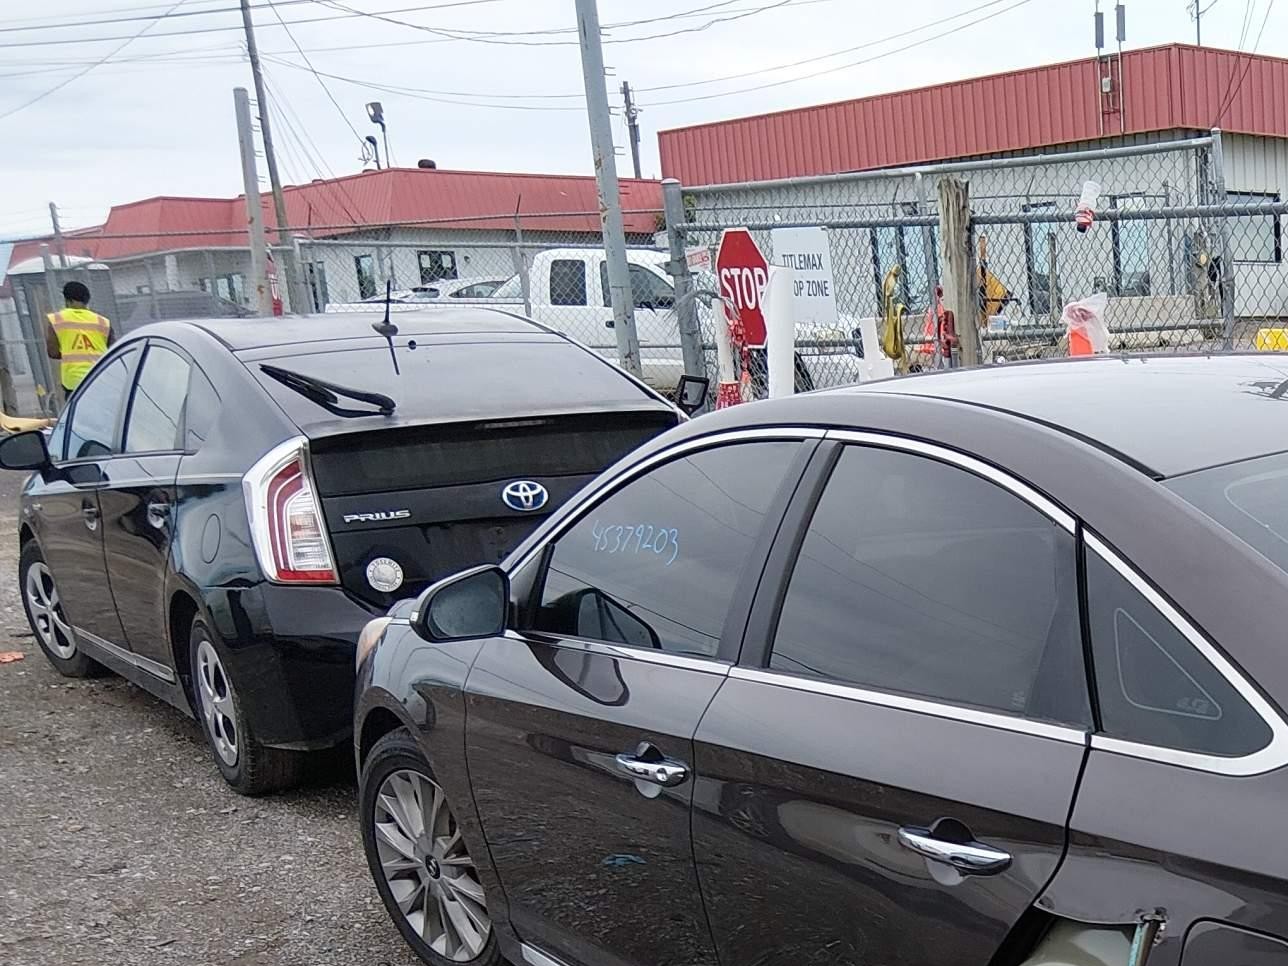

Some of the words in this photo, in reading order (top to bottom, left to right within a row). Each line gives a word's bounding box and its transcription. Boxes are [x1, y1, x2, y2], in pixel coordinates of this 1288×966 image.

[781, 252, 824, 270] TITLEMAX
[721, 267, 767, 310] STOP
[806, 280, 830, 297] ZONE
[343, 509, 411, 523] PRIUS
[592, 519, 679, 566] 45379203
